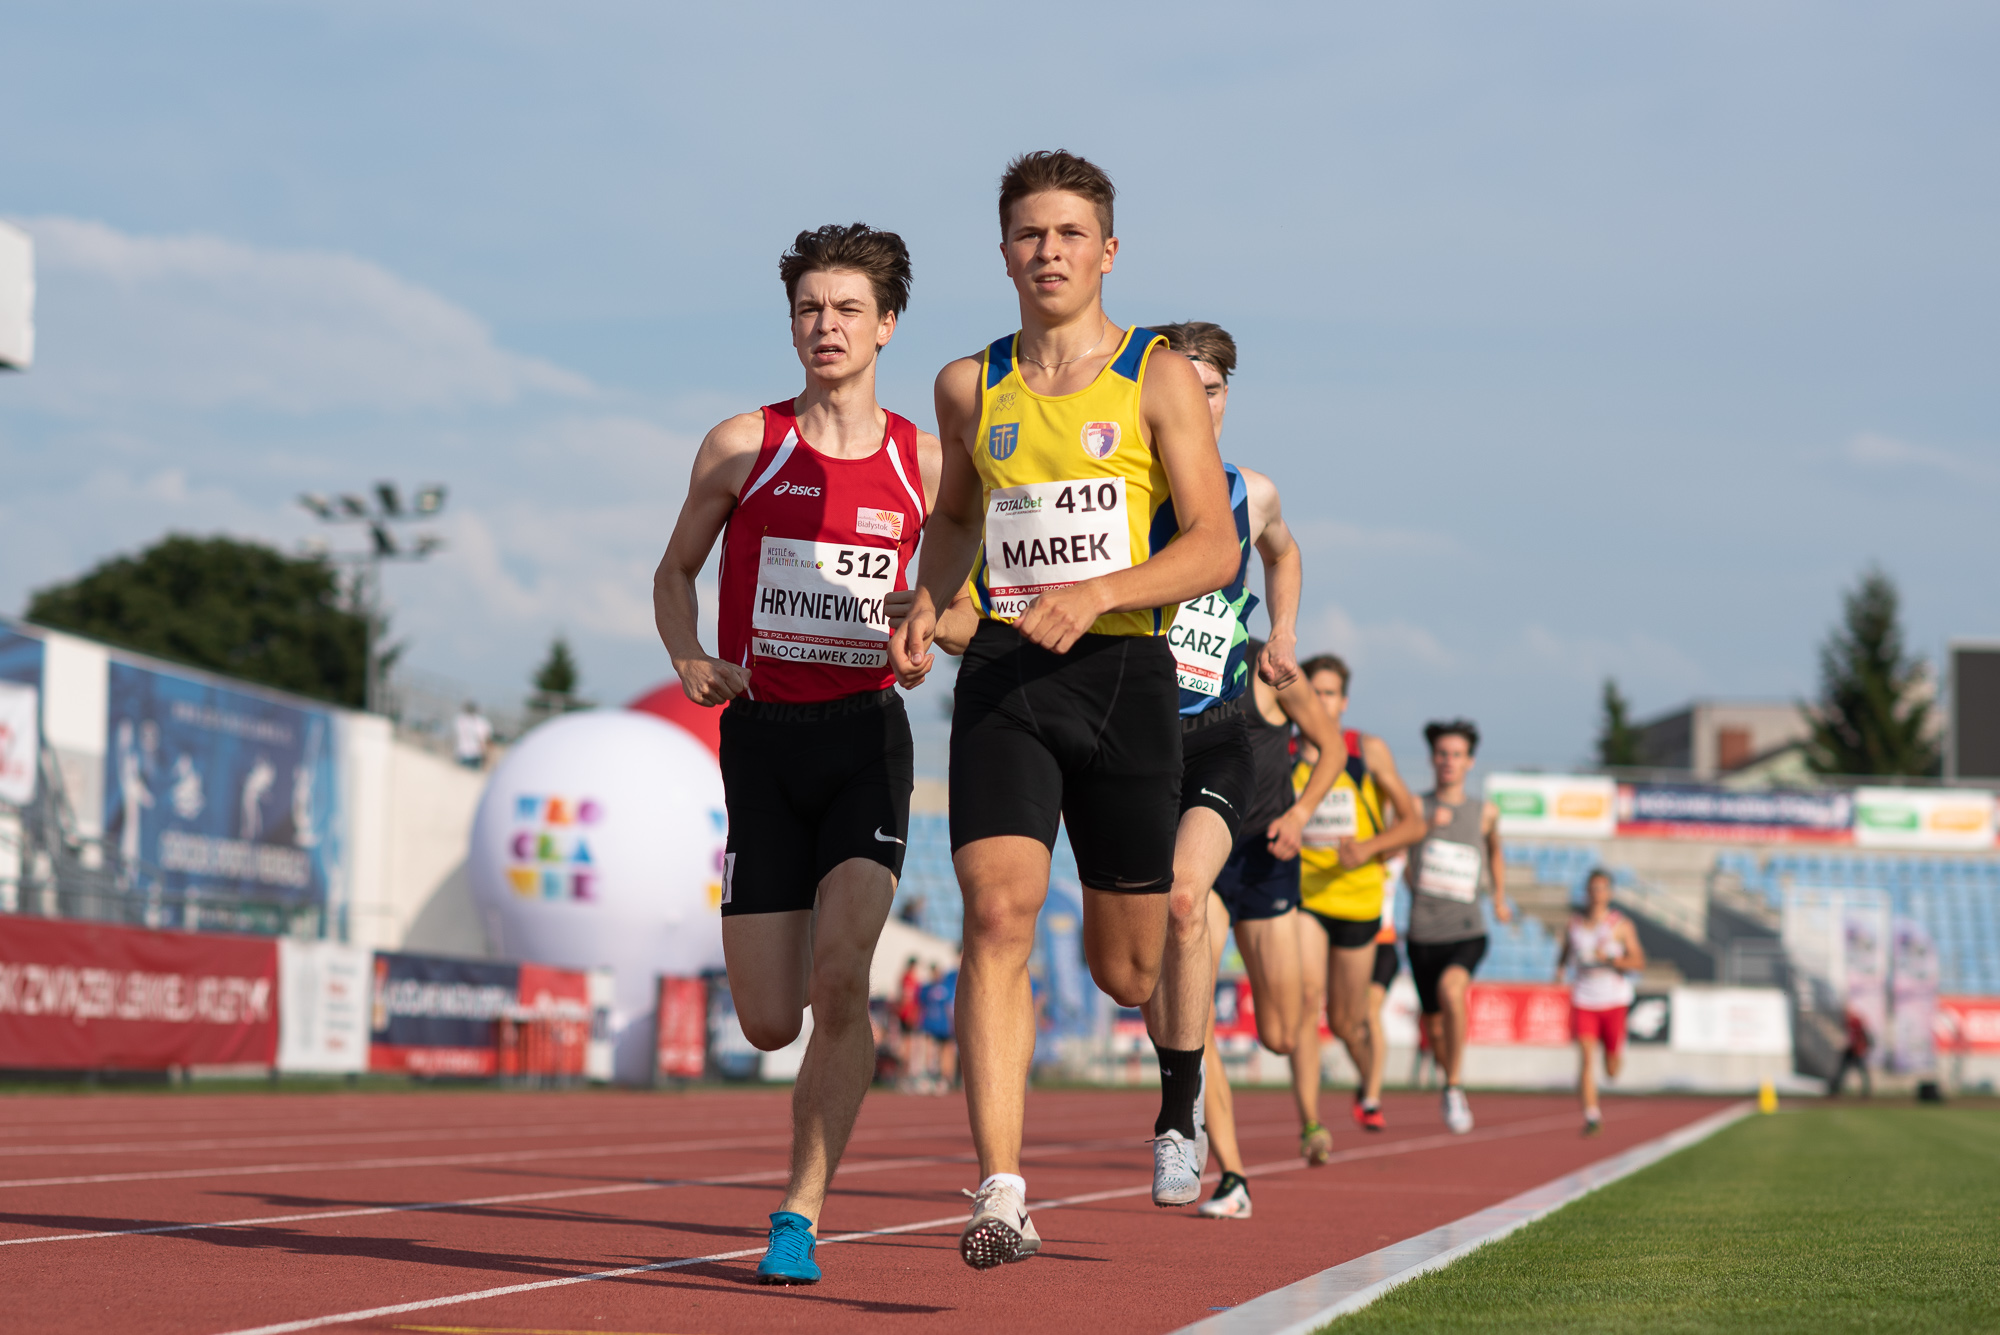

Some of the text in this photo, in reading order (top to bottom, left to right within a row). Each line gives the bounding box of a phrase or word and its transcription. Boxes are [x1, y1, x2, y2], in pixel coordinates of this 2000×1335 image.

[789, 485, 821, 497] asics
[1055, 483, 1118, 514] 410
[858, 520, 888, 532] Białystok
[767, 557, 815, 568] HEALTHIER KIDS
[768, 547, 787, 557] NESTLÉ
[1002, 533, 1111, 569] MAREK
[835, 550, 891, 580] 512
[760, 587, 886, 625] HRYNIEWICKI
[997, 600, 1029, 614] WŁO
[1185, 594, 1229, 618] 217
[1168, 624, 1227, 659] CARZ
[759, 642, 881, 666] WŁOCŁAWEK 2021
[1188, 678, 1214, 693] 2021
